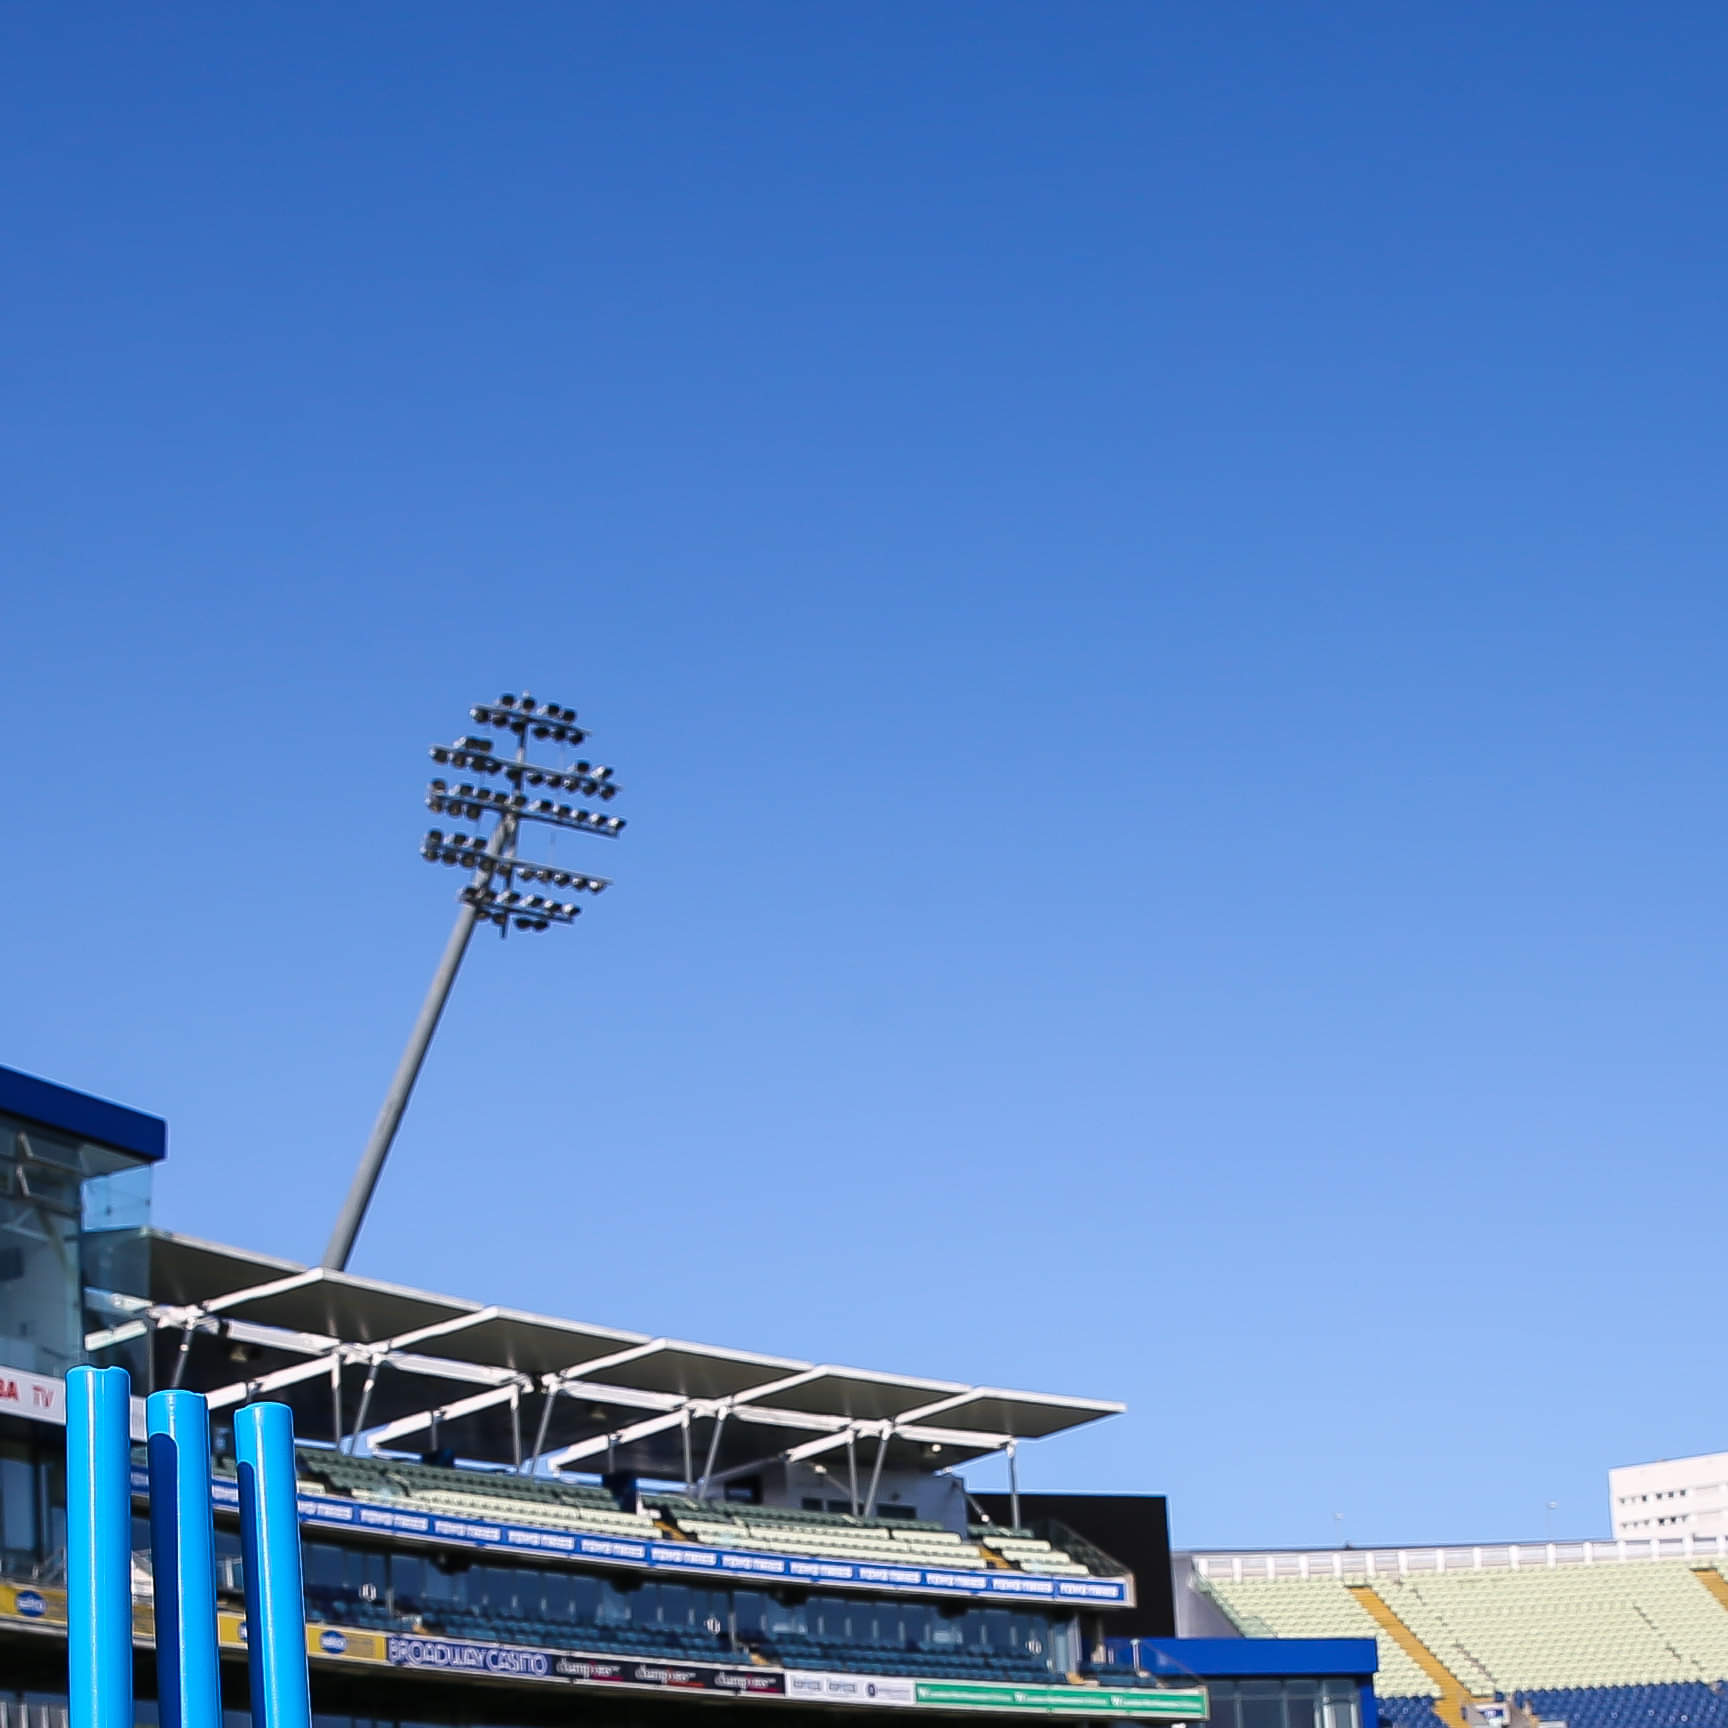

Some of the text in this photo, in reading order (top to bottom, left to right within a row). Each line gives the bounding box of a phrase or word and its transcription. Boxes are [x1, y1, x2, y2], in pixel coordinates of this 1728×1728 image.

[32, 1385, 54, 1408] TV
[388, 1637, 485, 1668] BROADWAY
[486, 1649, 547, 1676] CASINO
